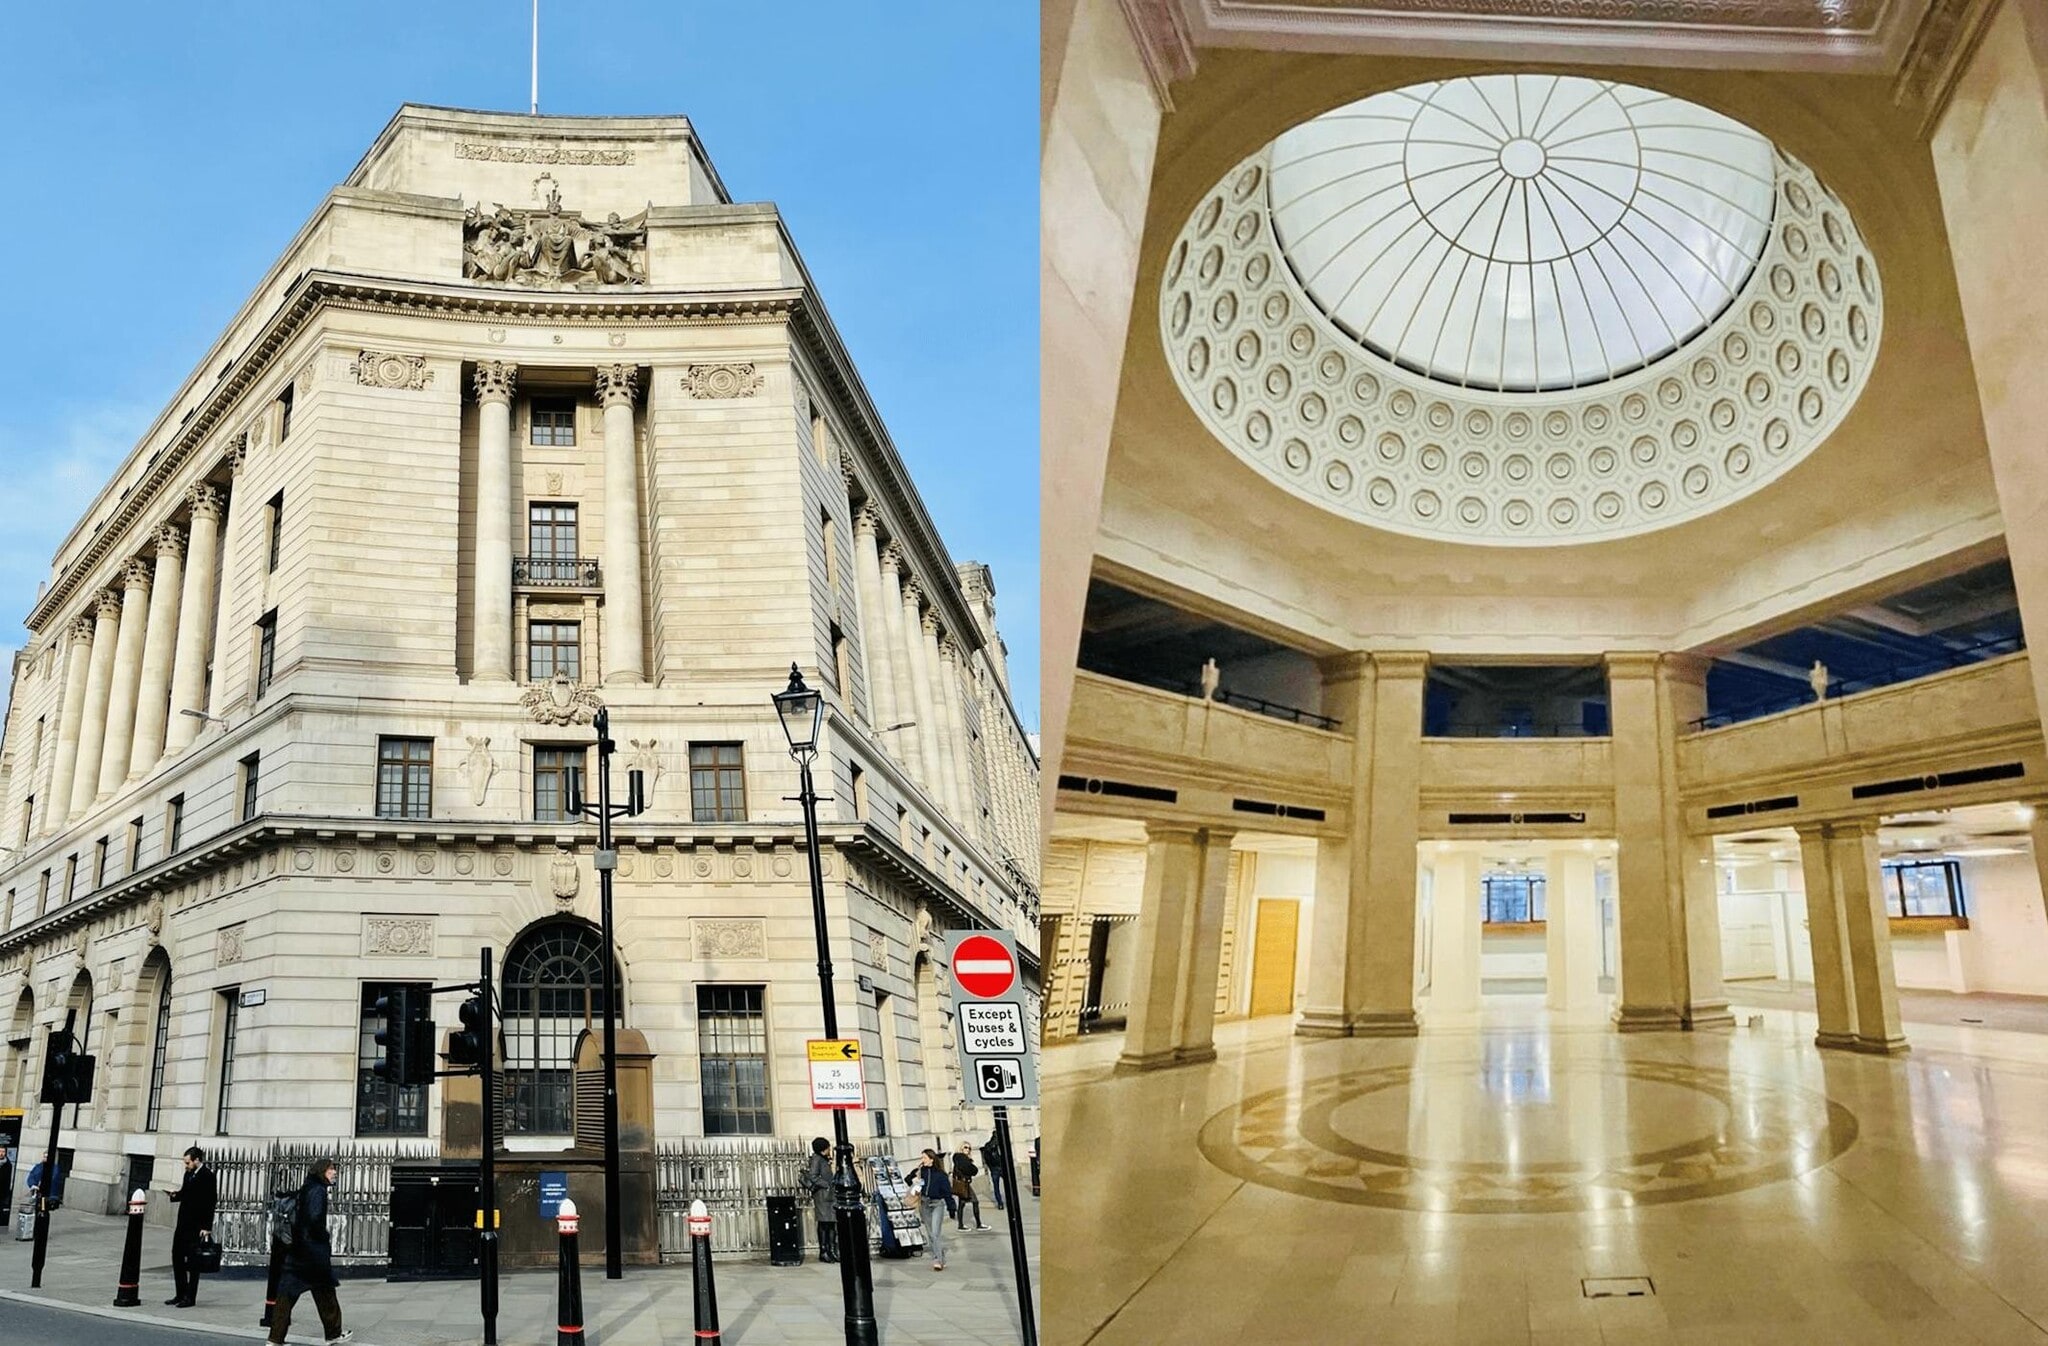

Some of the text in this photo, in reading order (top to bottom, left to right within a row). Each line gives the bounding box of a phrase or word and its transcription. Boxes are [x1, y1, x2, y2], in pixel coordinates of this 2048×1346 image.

[969, 1009, 1012, 1020] Except
[968, 1022, 1017, 1033] buses &
[975, 1036, 1014, 1049] cycles
[817, 1082, 860, 1090] N25 N550
